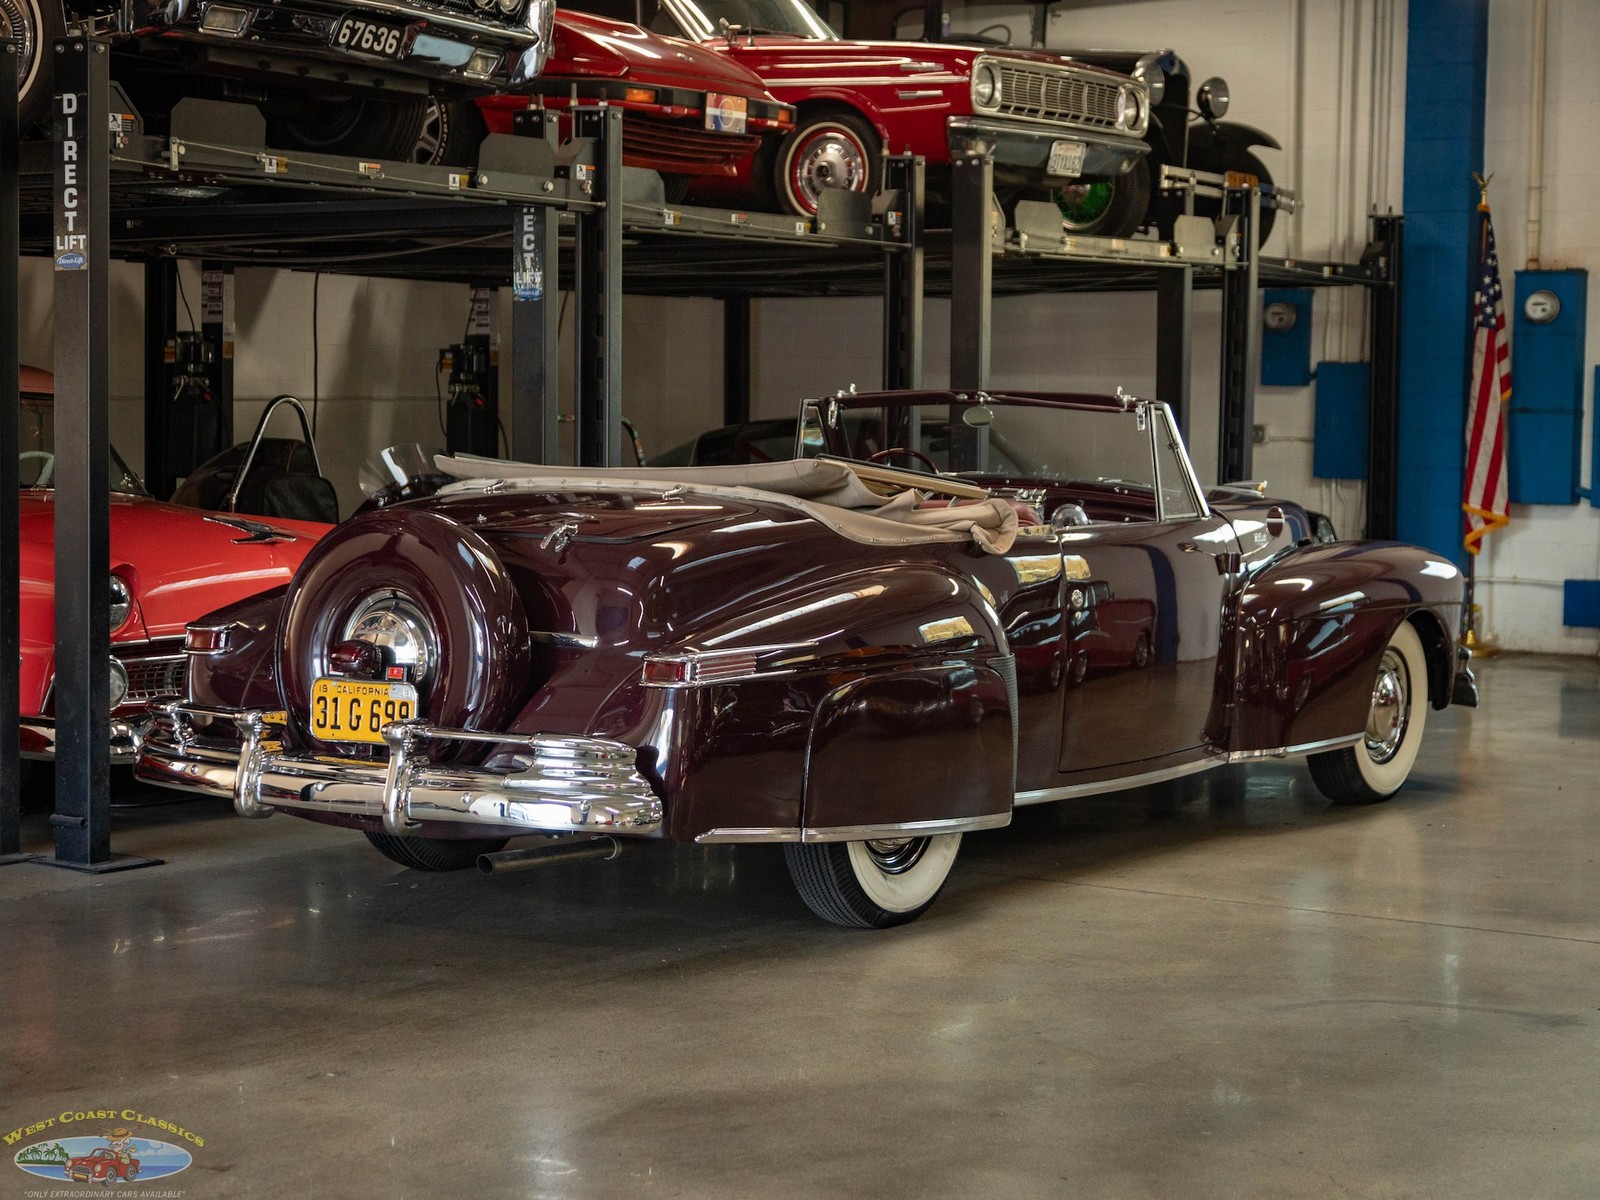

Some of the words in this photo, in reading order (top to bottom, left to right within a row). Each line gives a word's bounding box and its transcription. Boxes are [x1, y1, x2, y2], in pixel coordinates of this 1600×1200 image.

[338, 19, 400, 55] 67636
[62, 93, 78, 232] DIRECT
[56, 235, 87, 250] LIFT
[319, 684, 328, 693] 19
[336, 685, 389, 696] CALIFORNIA
[316, 696, 340, 729] 31
[350, 698, 362, 731] G
